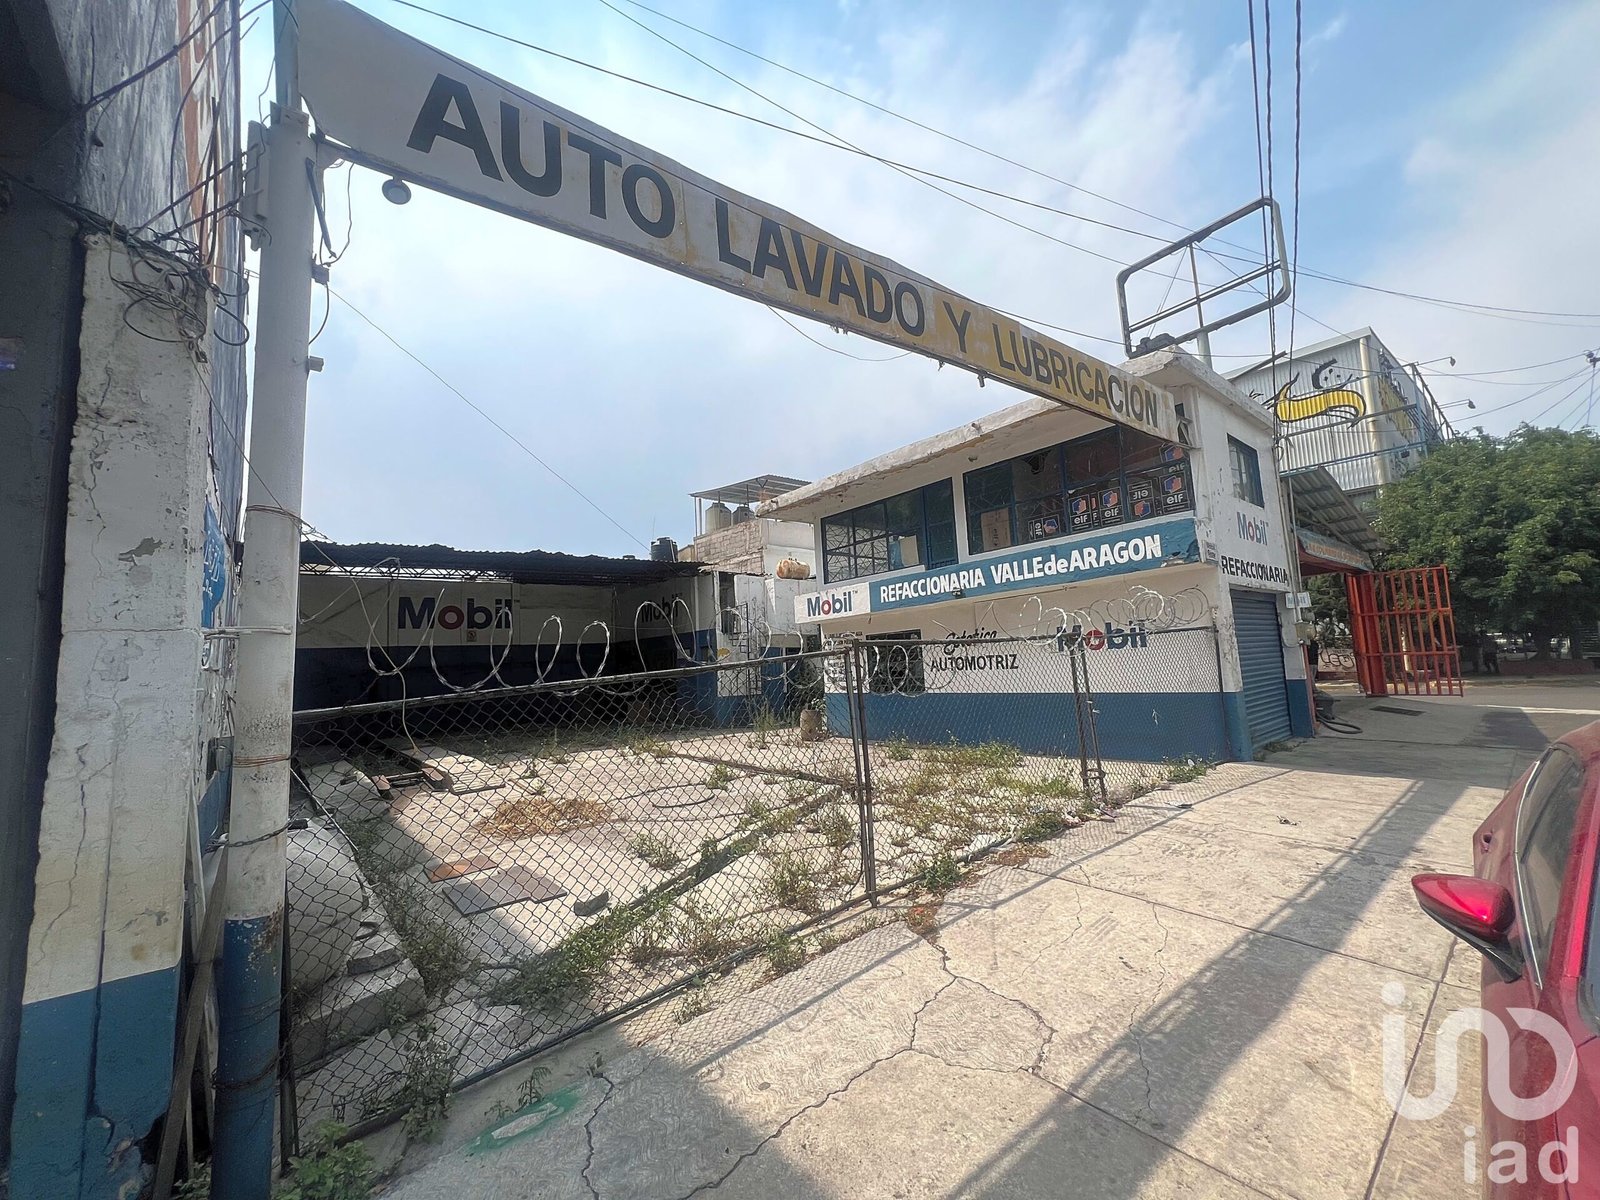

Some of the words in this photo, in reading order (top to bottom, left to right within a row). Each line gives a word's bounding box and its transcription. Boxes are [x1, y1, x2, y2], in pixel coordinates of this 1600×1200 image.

[405, 73, 676, 240] AUTO
[714, 197, 926, 338] LAVADO
[943, 302, 971, 354] Y
[991, 322, 1159, 429] LUBRICACION
[1103, 507, 1119, 518] elf
[1166, 493, 1184, 505] elf
[1073, 515, 1089, 525] elf
[1236, 511, 1268, 546] Mobil
[1220, 555, 1289, 584] REFACCIONARIA
[879, 567, 986, 604] REFACCIONARIA
[397, 596, 513, 630] Mobil
[806, 590, 853, 618] Mobil
[930, 653, 1019, 672] AUTOMOTRIZ
